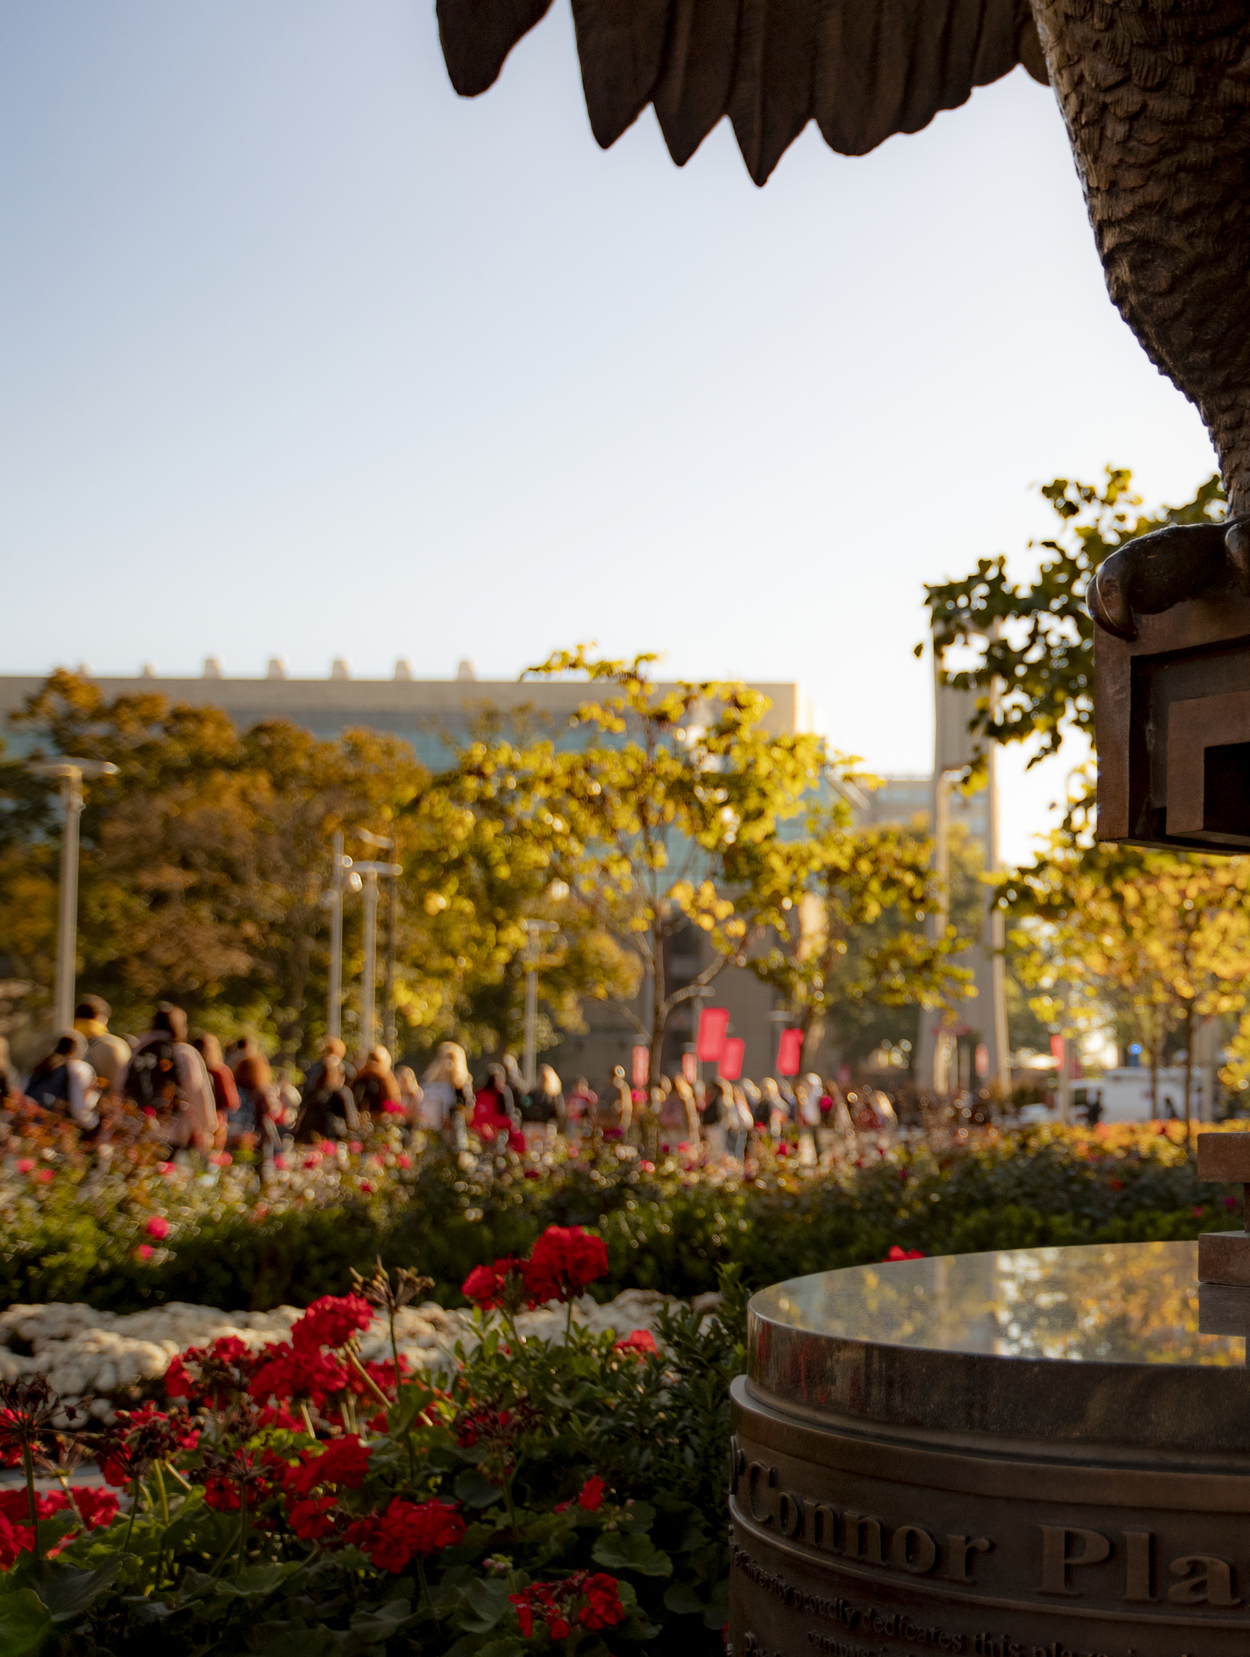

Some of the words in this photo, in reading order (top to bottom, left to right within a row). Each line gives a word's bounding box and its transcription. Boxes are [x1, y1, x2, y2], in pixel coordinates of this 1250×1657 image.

[794, 1589, 859, 1629] proudly
[862, 1607, 965, 1651] dedicates
[972, 1631, 1025, 1657] this
